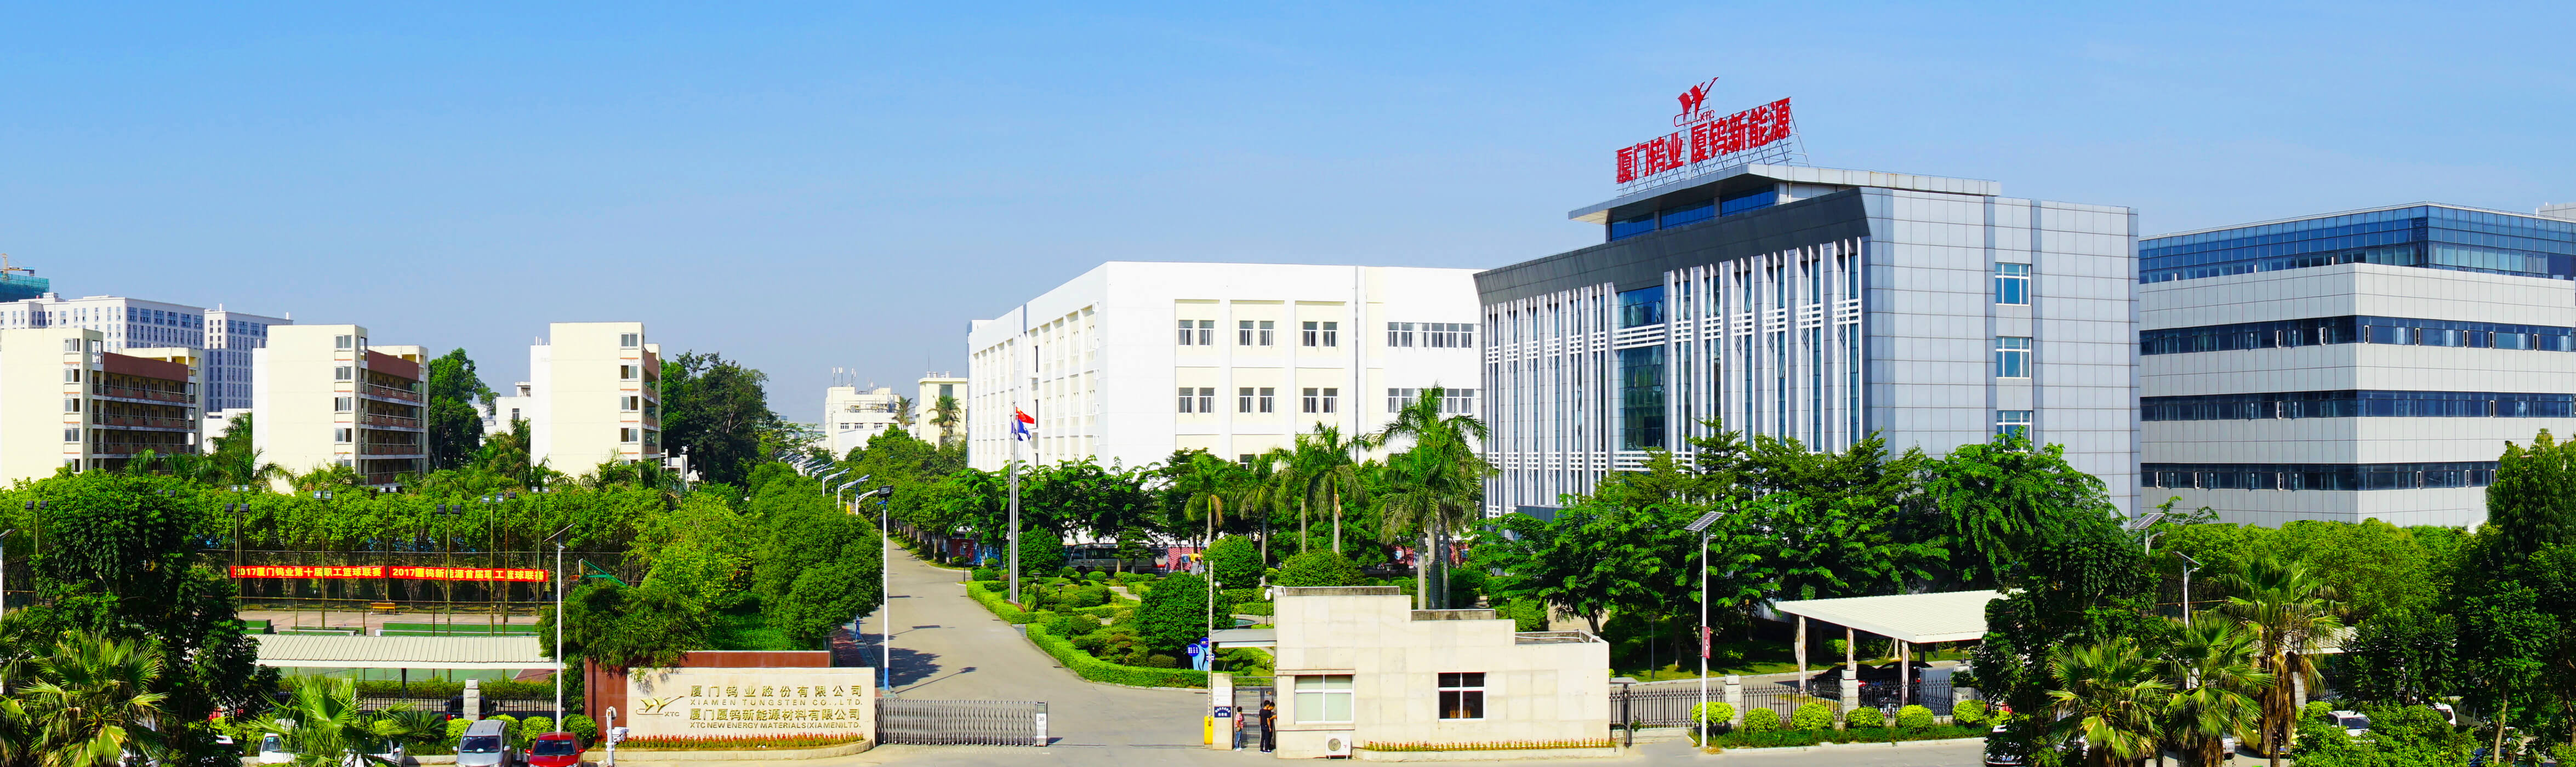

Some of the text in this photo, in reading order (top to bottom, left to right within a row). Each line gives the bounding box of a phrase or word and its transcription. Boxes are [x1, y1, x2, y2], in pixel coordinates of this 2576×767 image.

[1616, 98, 1789, 183] 厦门钨业 厦钨新能源
[690, 685, 862, 697] 厦门钨业股份有限公司
[689, 708, 860, 721] 厦门厦钨新能源材料有限公司
